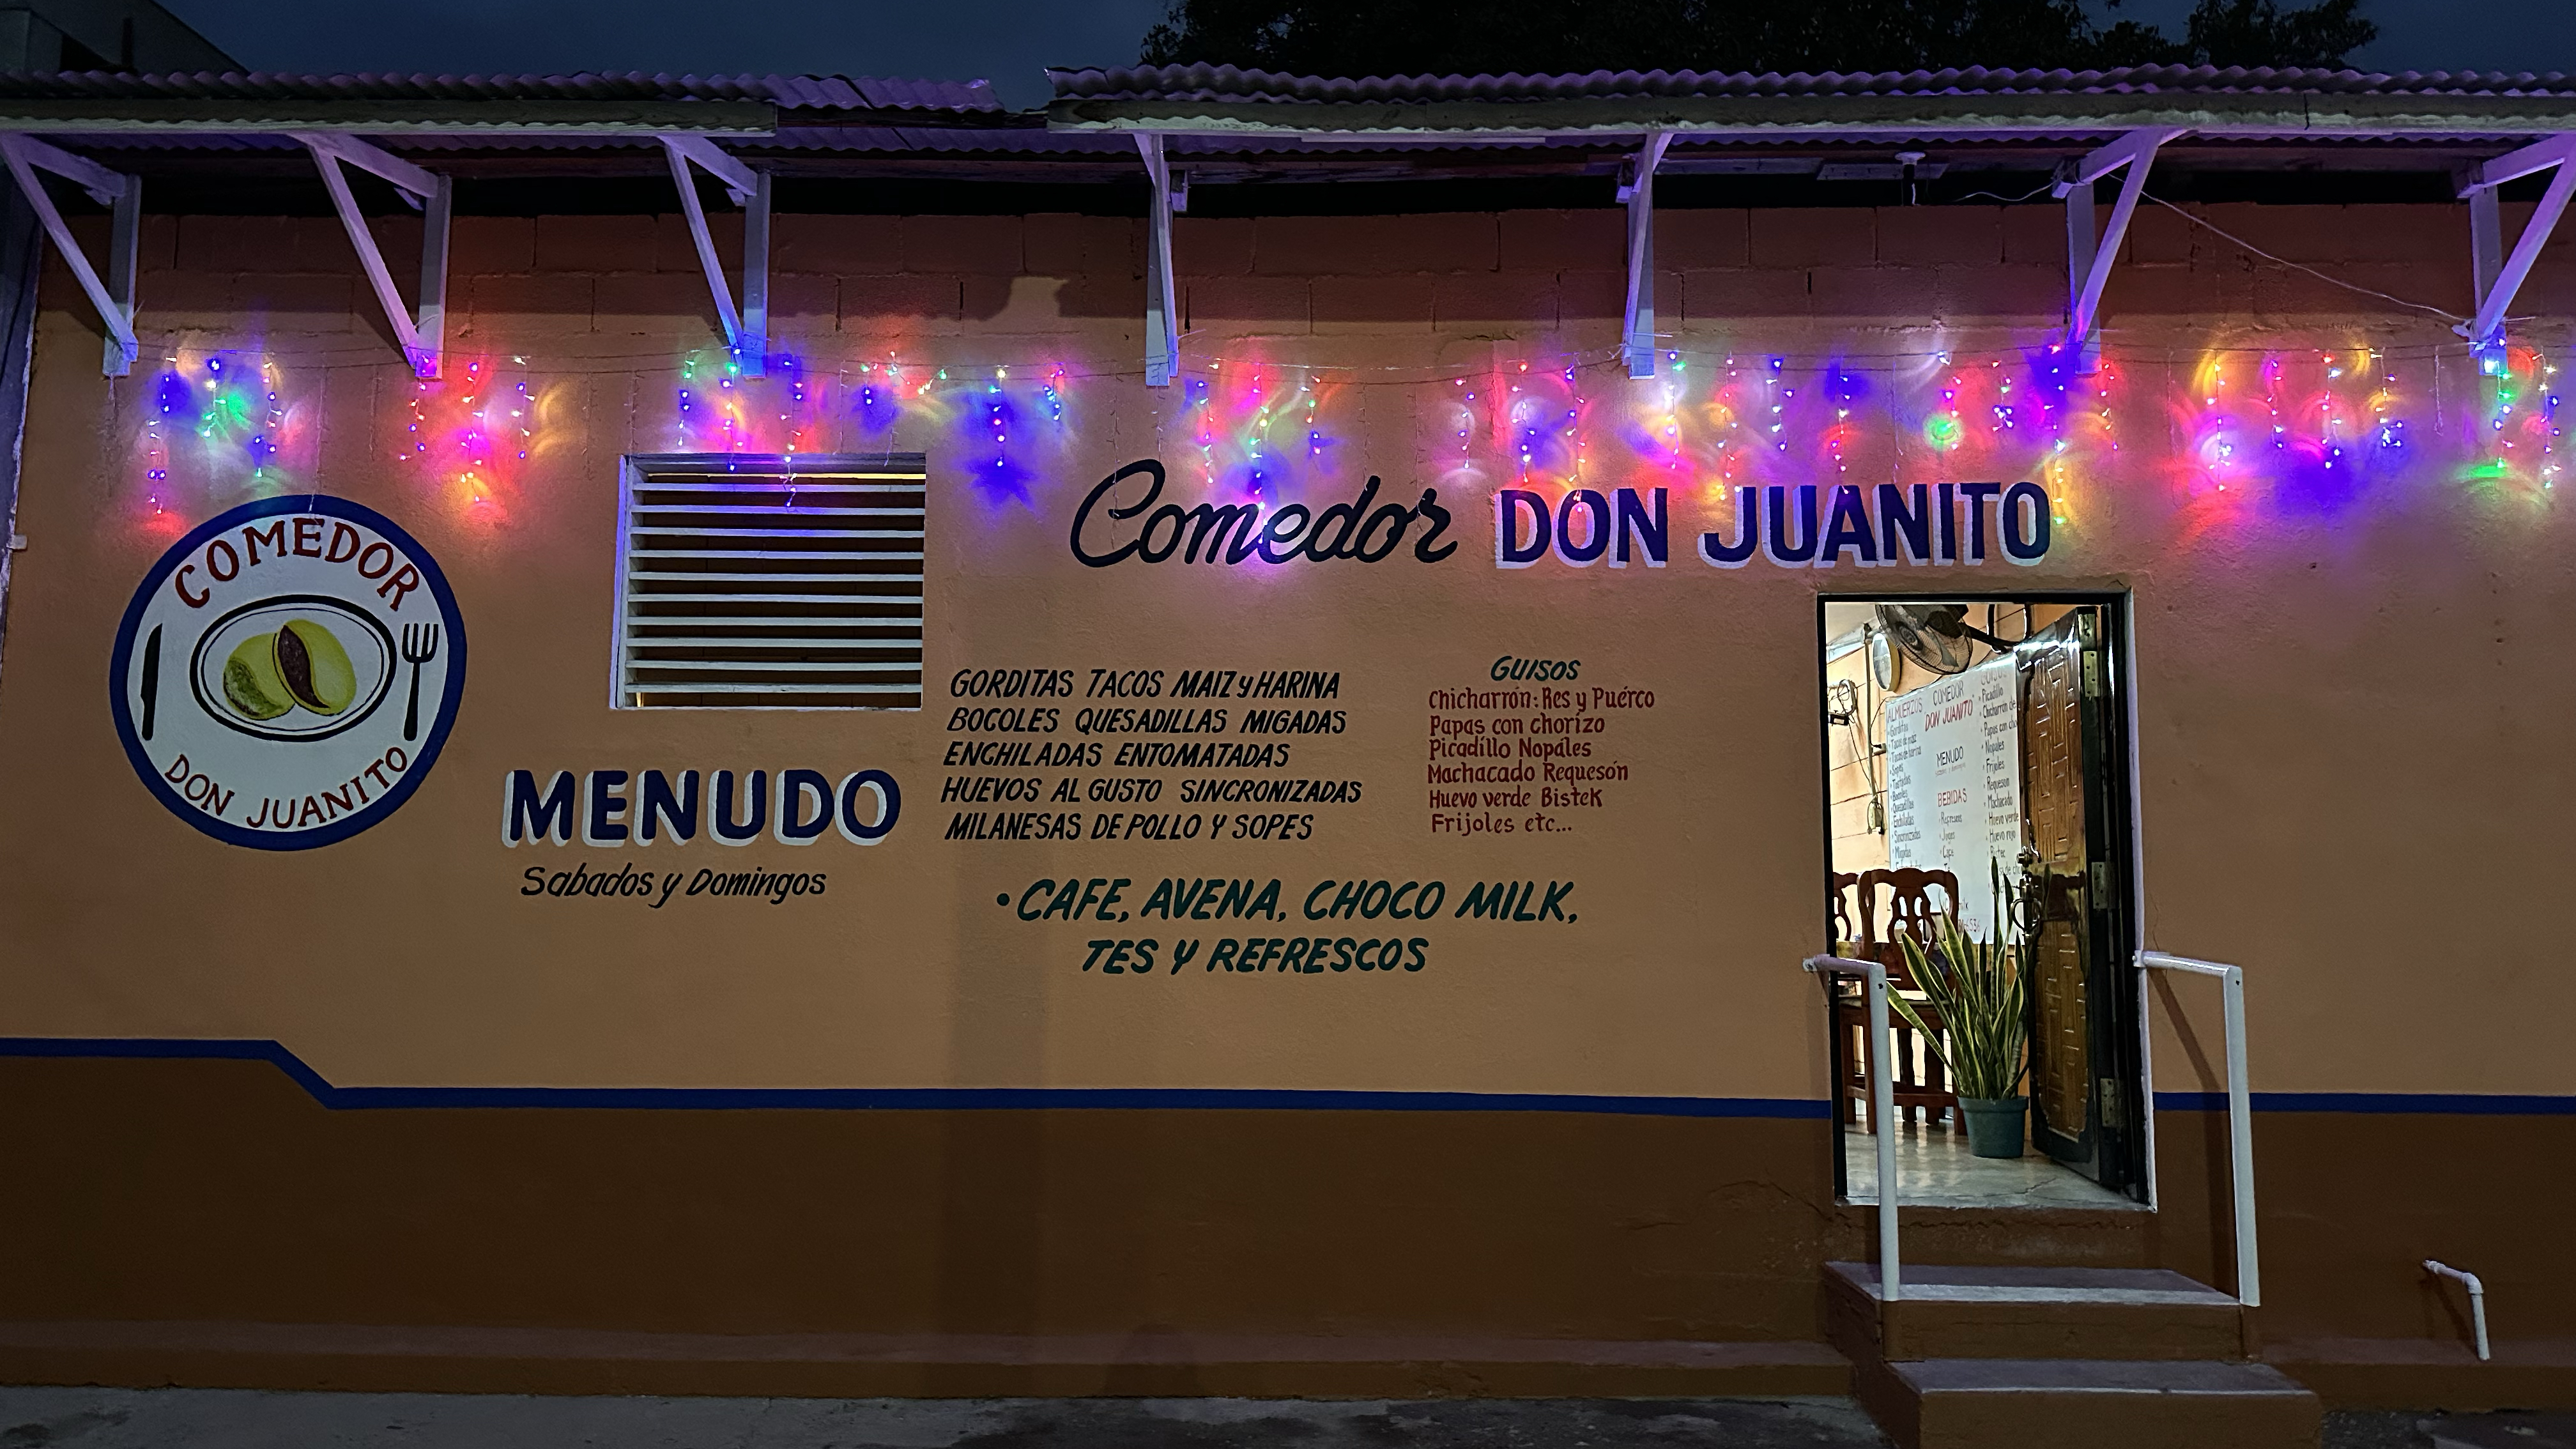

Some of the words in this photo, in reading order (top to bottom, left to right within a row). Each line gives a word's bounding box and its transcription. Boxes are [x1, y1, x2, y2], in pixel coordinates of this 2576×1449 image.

[1070, 459, 1459, 568] Comedor
[1495, 487, 1669, 569] DON
[1698, 481, 2051, 568] JUANITO
[175, 518, 419, 611] COMEDOR
[1491, 656, 1581, 681] GUISOS
[950, 669, 1074, 698] GORDITAS
[1085, 669, 1164, 698] TACOS
[1170, 670, 1238, 698] MAIZ
[1251, 671, 1340, 699] HARINA
[1933, 680, 1964, 706] COMEDOR
[1982, 683, 2004, 703] Picadillo
[1542, 687, 1570, 709] Res
[1575, 692, 1586, 712] y
[1887, 697, 1923, 723] ALMUERZOS
[946, 707, 1061, 733] BOCOLES
[1075, 707, 1228, 735] QUESADILLAS
[1239, 709, 1347, 734] MIGADAS
[1430, 715, 1485, 740] Papas
[1492, 718, 1524, 735] con
[1984, 721, 1998, 739] Papas
[943, 740, 1103, 767] ENCHILADAS
[1114, 742, 1291, 768] ENTOMATADAS
[1936, 746, 1964, 767] MENUDO
[1986, 737, 2004, 756] Nopales
[1428, 759, 1535, 784] Machacado
[1542, 760, 1629, 786] Requesón
[1986, 756, 2005, 774] Frijoles
[164, 755, 235, 816] DON
[247, 747, 408, 829] JUANITO
[940, 776, 1042, 803] HUEVOS
[1050, 778, 1081, 802] AL
[1088, 778, 1163, 803] GUSTO
[1180, 779, 1363, 804] SINCRONIZADAS
[1430, 790, 1477, 809] Huevo
[1482, 785, 1531, 807] verde
[1938, 788, 1967, 807] BEBIDAS
[502, 769, 901, 848] MENUDO
[1989, 811, 2004, 826] Huevo
[2005, 807, 2019, 824] verde
[944, 812, 1082, 840] MILANESAS
[1091, 813, 1123, 839] DE
[1124, 813, 1202, 840] POLLO
[1211, 814, 1226, 839] Y
[1232, 813, 1314, 840] SOPES
[1431, 812, 1515, 837] Frijoles
[1524, 812, 1572, 832] etc...
[1989, 828, 2005, 843] Huevo
[521, 862, 654, 898] Sabados
[648, 873, 683, 908] y
[686, 867, 827, 905] Domingos
[1017, 878, 1132, 923] CAFE,
[1140, 878, 1287, 923] AVENA,
[1303, 880, 1446, 922] CHOCO
[1454, 882, 1578, 924] MILK,
[1081, 939, 1160, 975] TES
[1207, 937, 1429, 975] REFRESCOS
